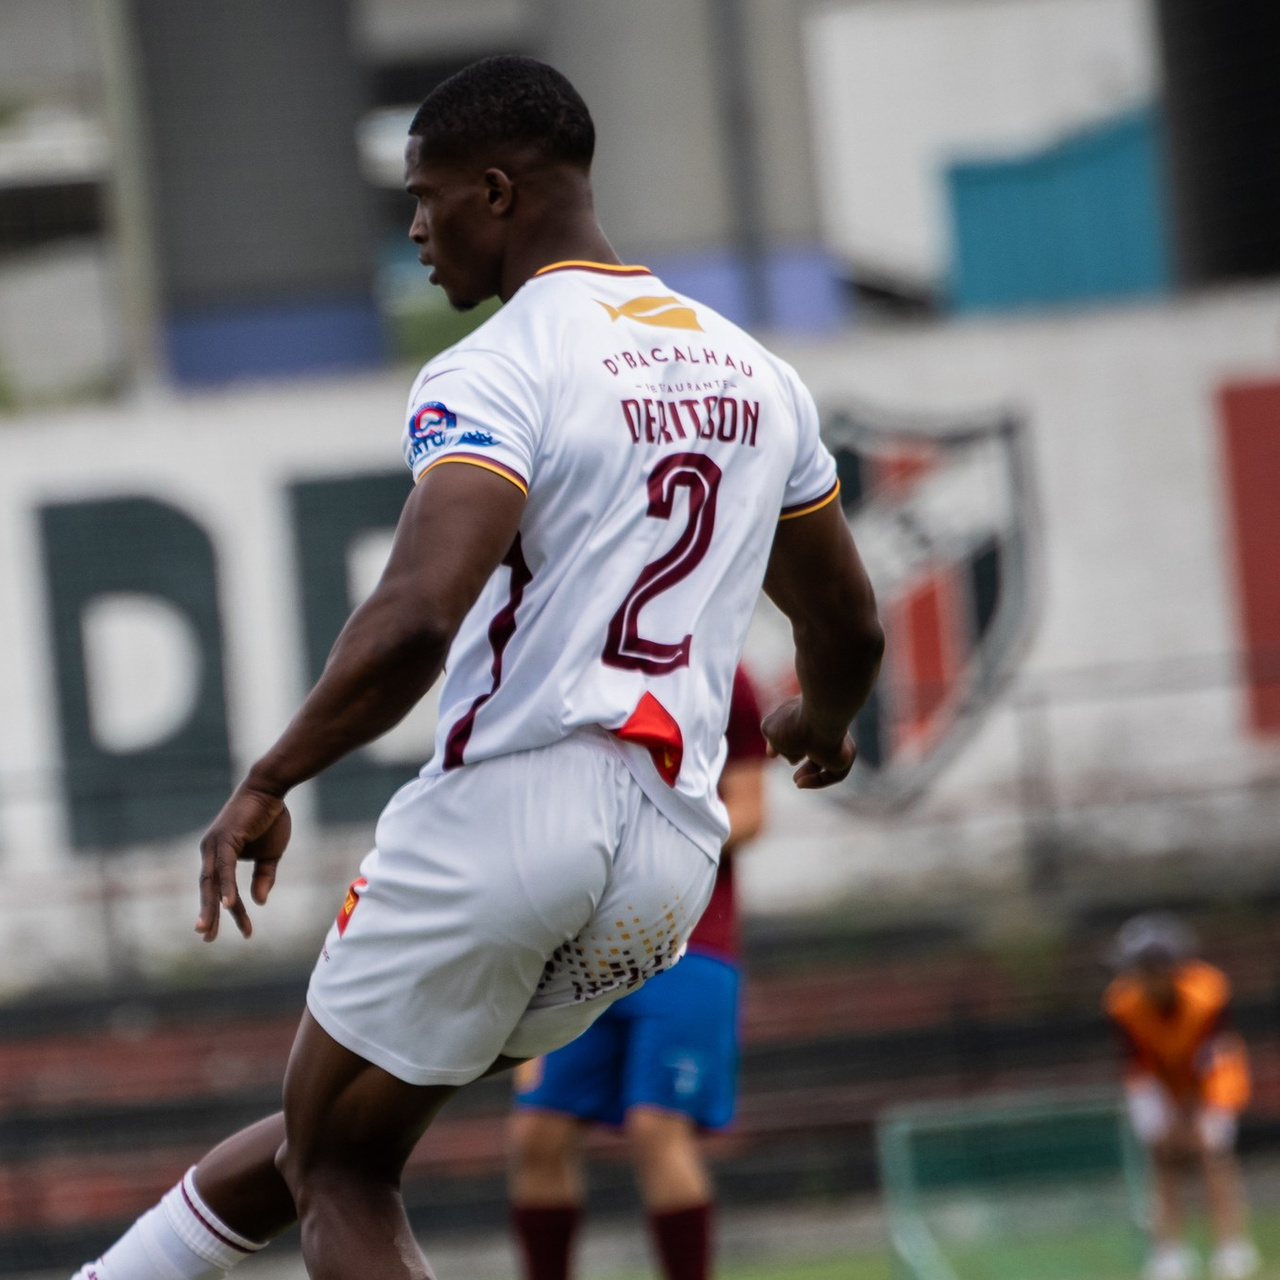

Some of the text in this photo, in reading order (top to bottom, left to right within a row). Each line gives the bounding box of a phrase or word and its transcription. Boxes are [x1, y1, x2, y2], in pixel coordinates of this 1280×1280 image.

[603, 346, 753, 377] D'BACALHAU
[645, 380, 729, 393] EAURANTE
[620, 395, 759, 447] DERITSON
[601, 452, 723, 676] 2
